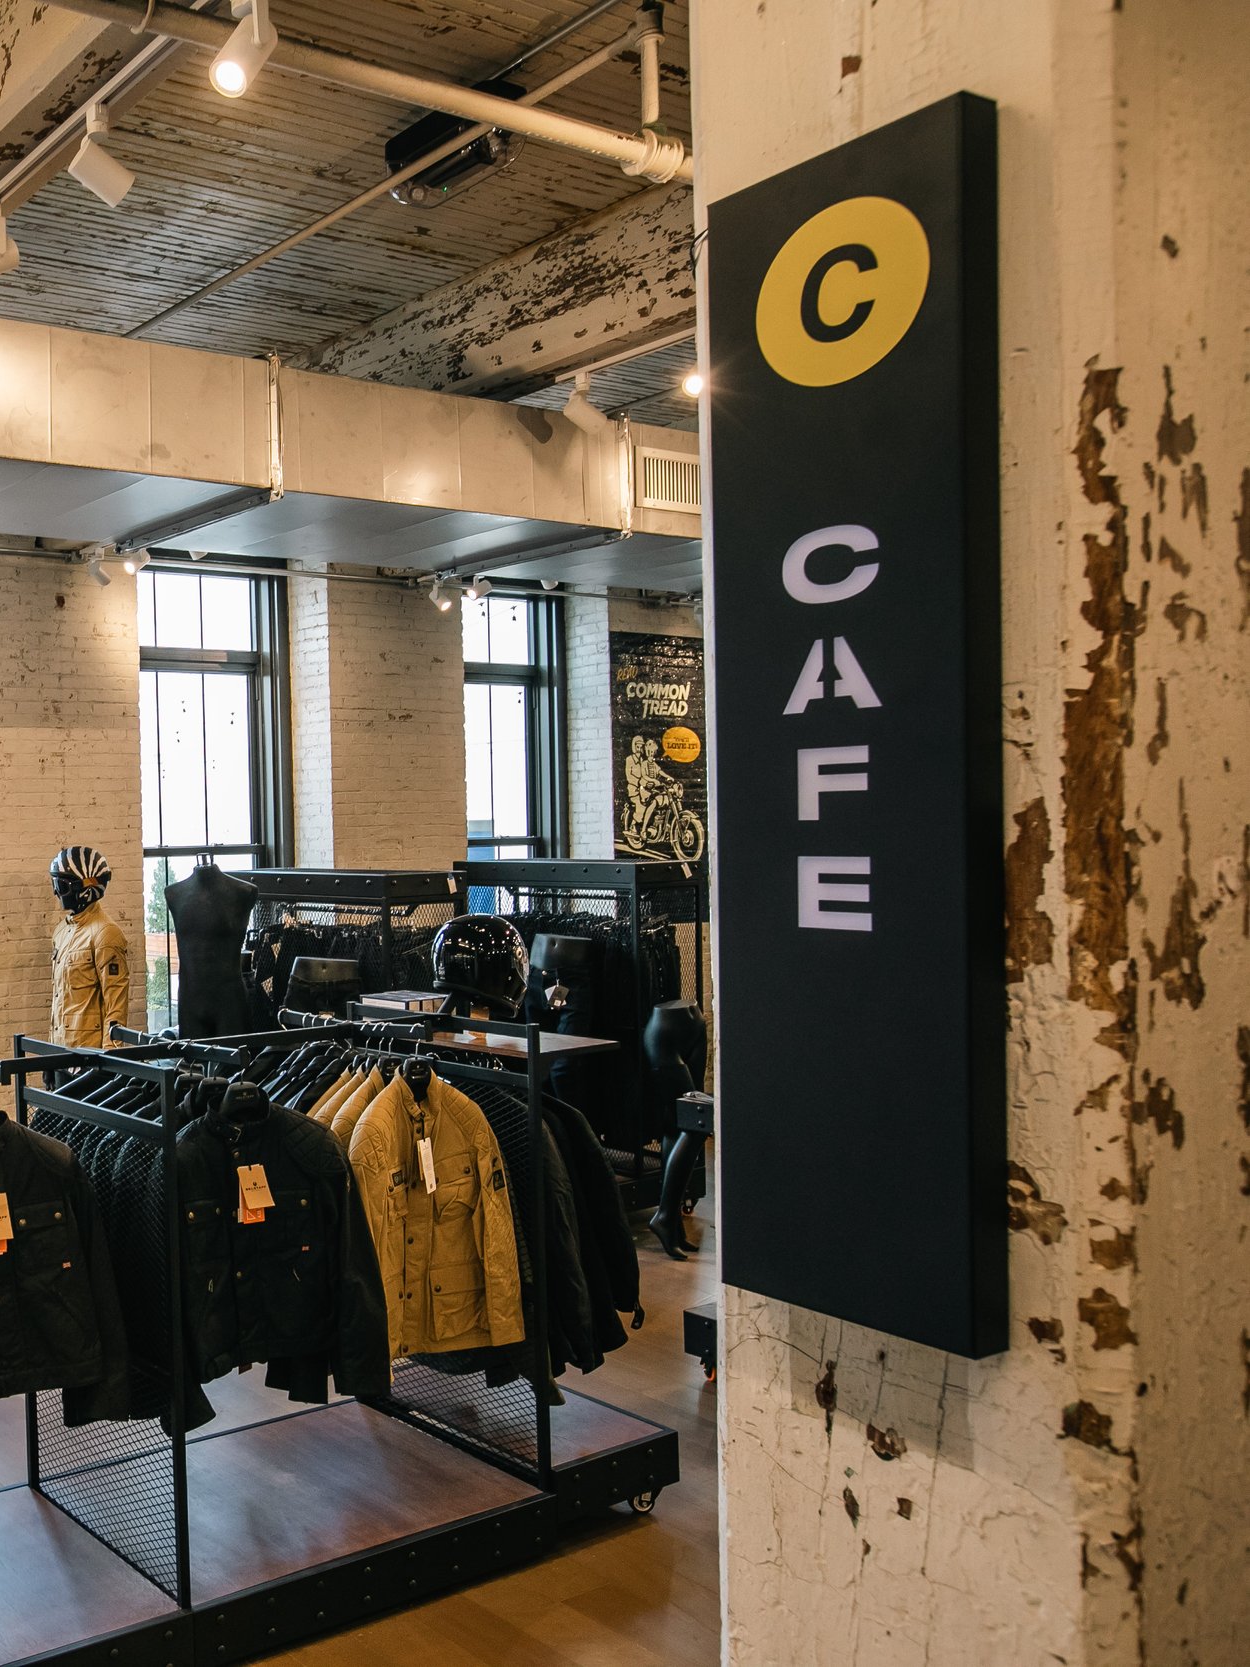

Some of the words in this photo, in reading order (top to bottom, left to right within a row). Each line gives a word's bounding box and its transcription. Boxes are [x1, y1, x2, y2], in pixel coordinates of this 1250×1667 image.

[799, 242, 879, 343] C
[626, 681, 691, 701] COMMON
[642, 699, 688, 719] TREAD
[781, 523, 883, 933] CAFE
[667, 742, 687, 750] LOVE
